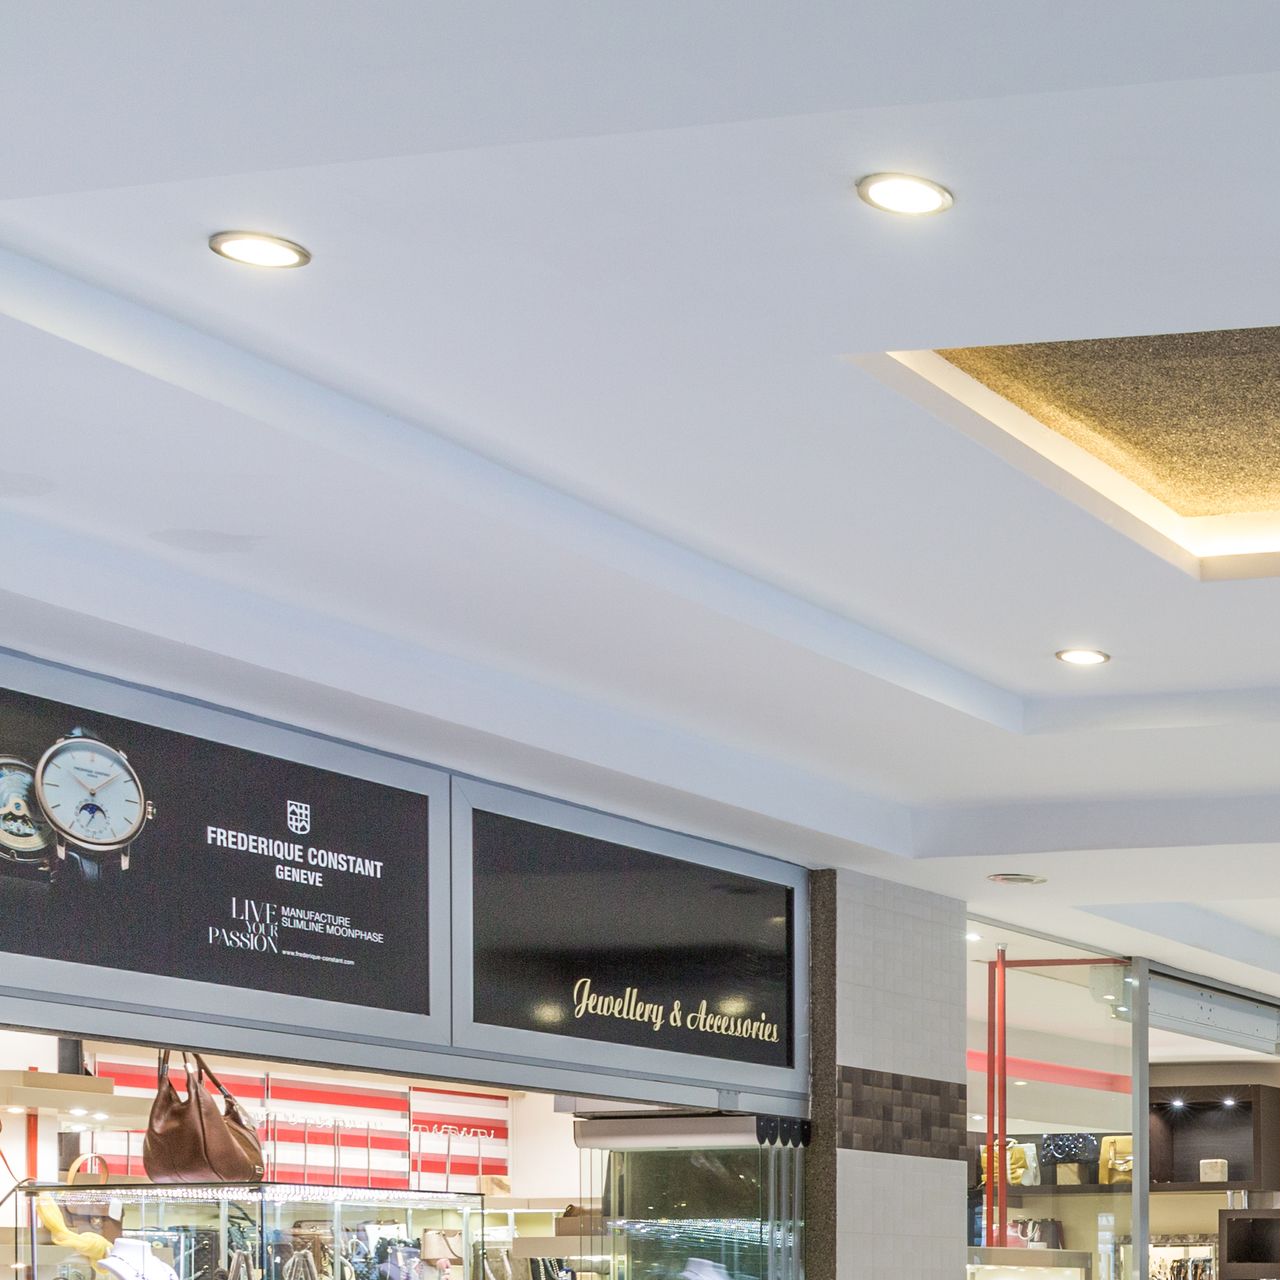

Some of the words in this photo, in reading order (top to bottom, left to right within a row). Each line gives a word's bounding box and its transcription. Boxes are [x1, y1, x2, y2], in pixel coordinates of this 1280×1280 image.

[207, 825, 304, 862] FREDERIQUE
[307, 847, 384, 878] CONSTANT
[275, 864, 323, 887] GENEVE
[231, 896, 278, 925] LIVE
[281, 905, 351, 928] MANUFACTURE
[208, 926, 279, 953] PASSION
[245, 920, 279, 937] YOUR
[281, 916, 325, 933] SLIMLINE
[325, 924, 385, 943] MOONPHASE
[573, 978, 665, 1031] Jewellery
[669, 1000, 682, 1027] &
[686, 999, 779, 1043] Accessories
